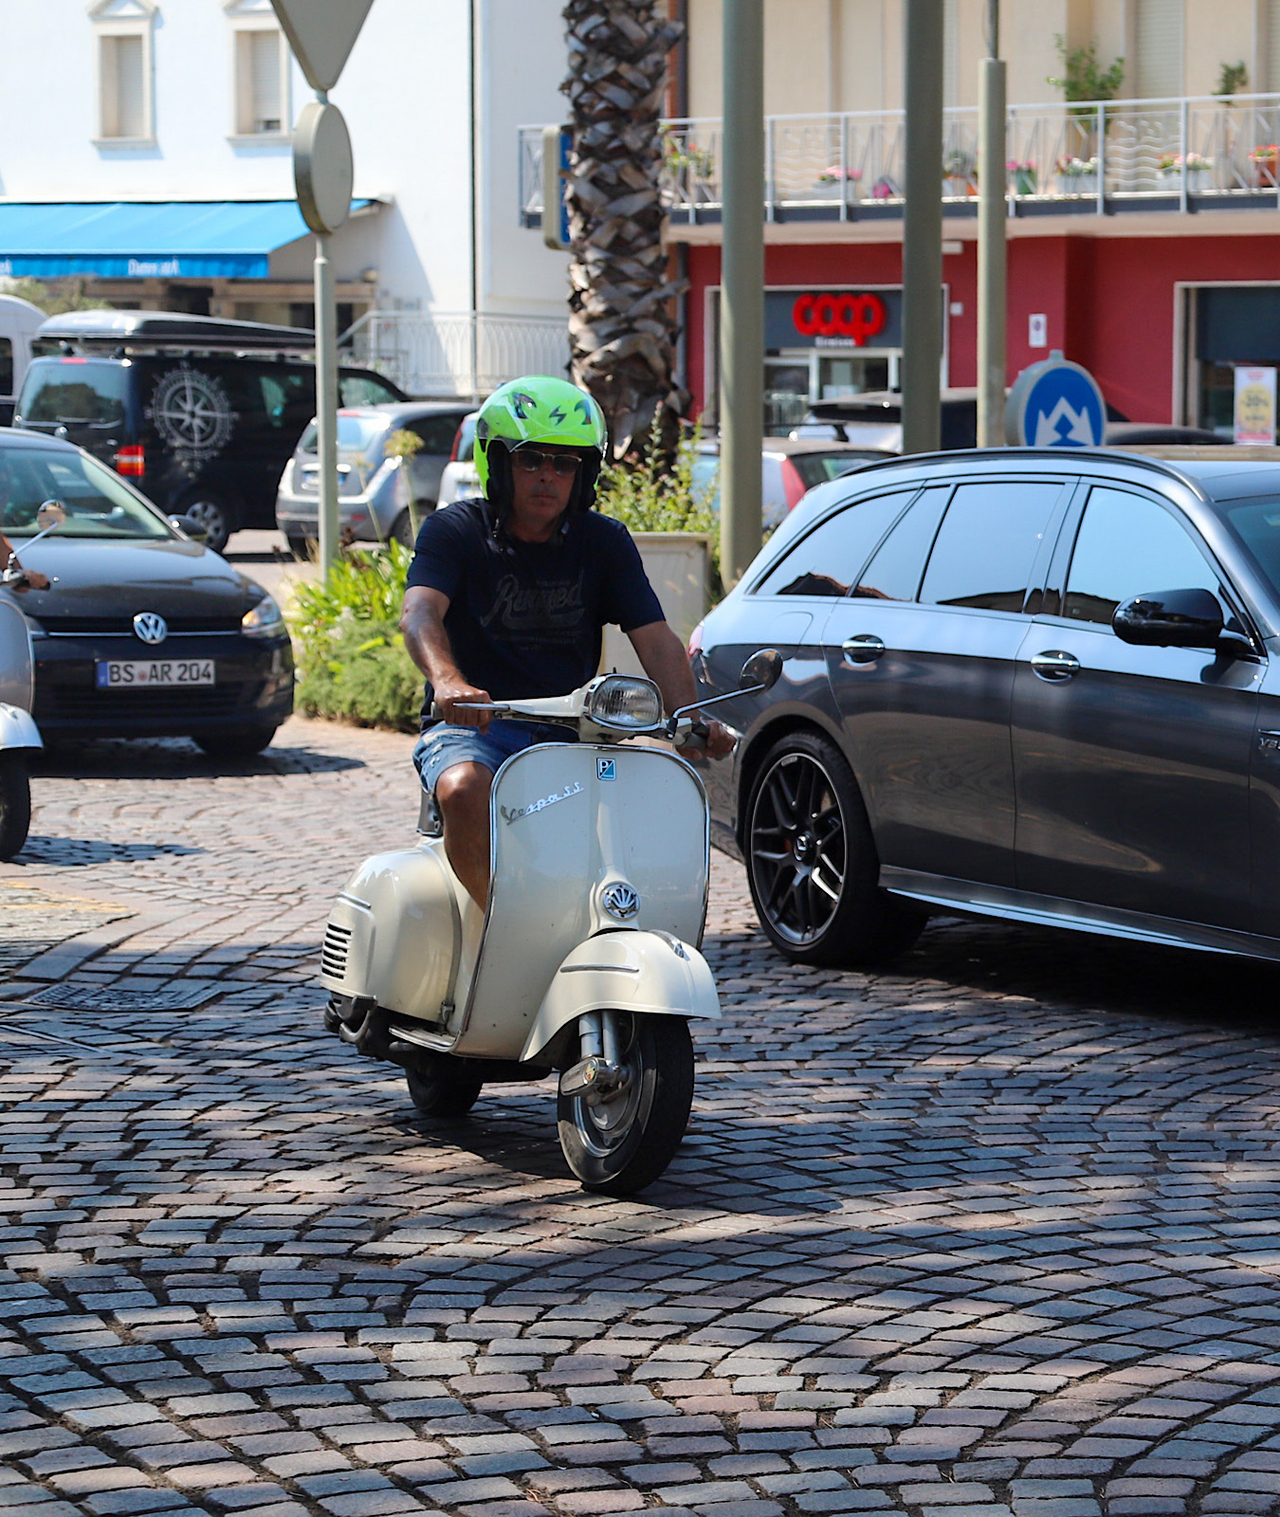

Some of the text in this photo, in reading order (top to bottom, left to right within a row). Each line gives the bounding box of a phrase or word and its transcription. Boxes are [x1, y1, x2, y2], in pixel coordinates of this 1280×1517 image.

[792, 293, 886, 346] coop
[109, 664, 134, 683] BS
[149, 664, 171, 681] AR
[177, 663, 212, 682] 204
[501, 794, 561, 826] Vespa
